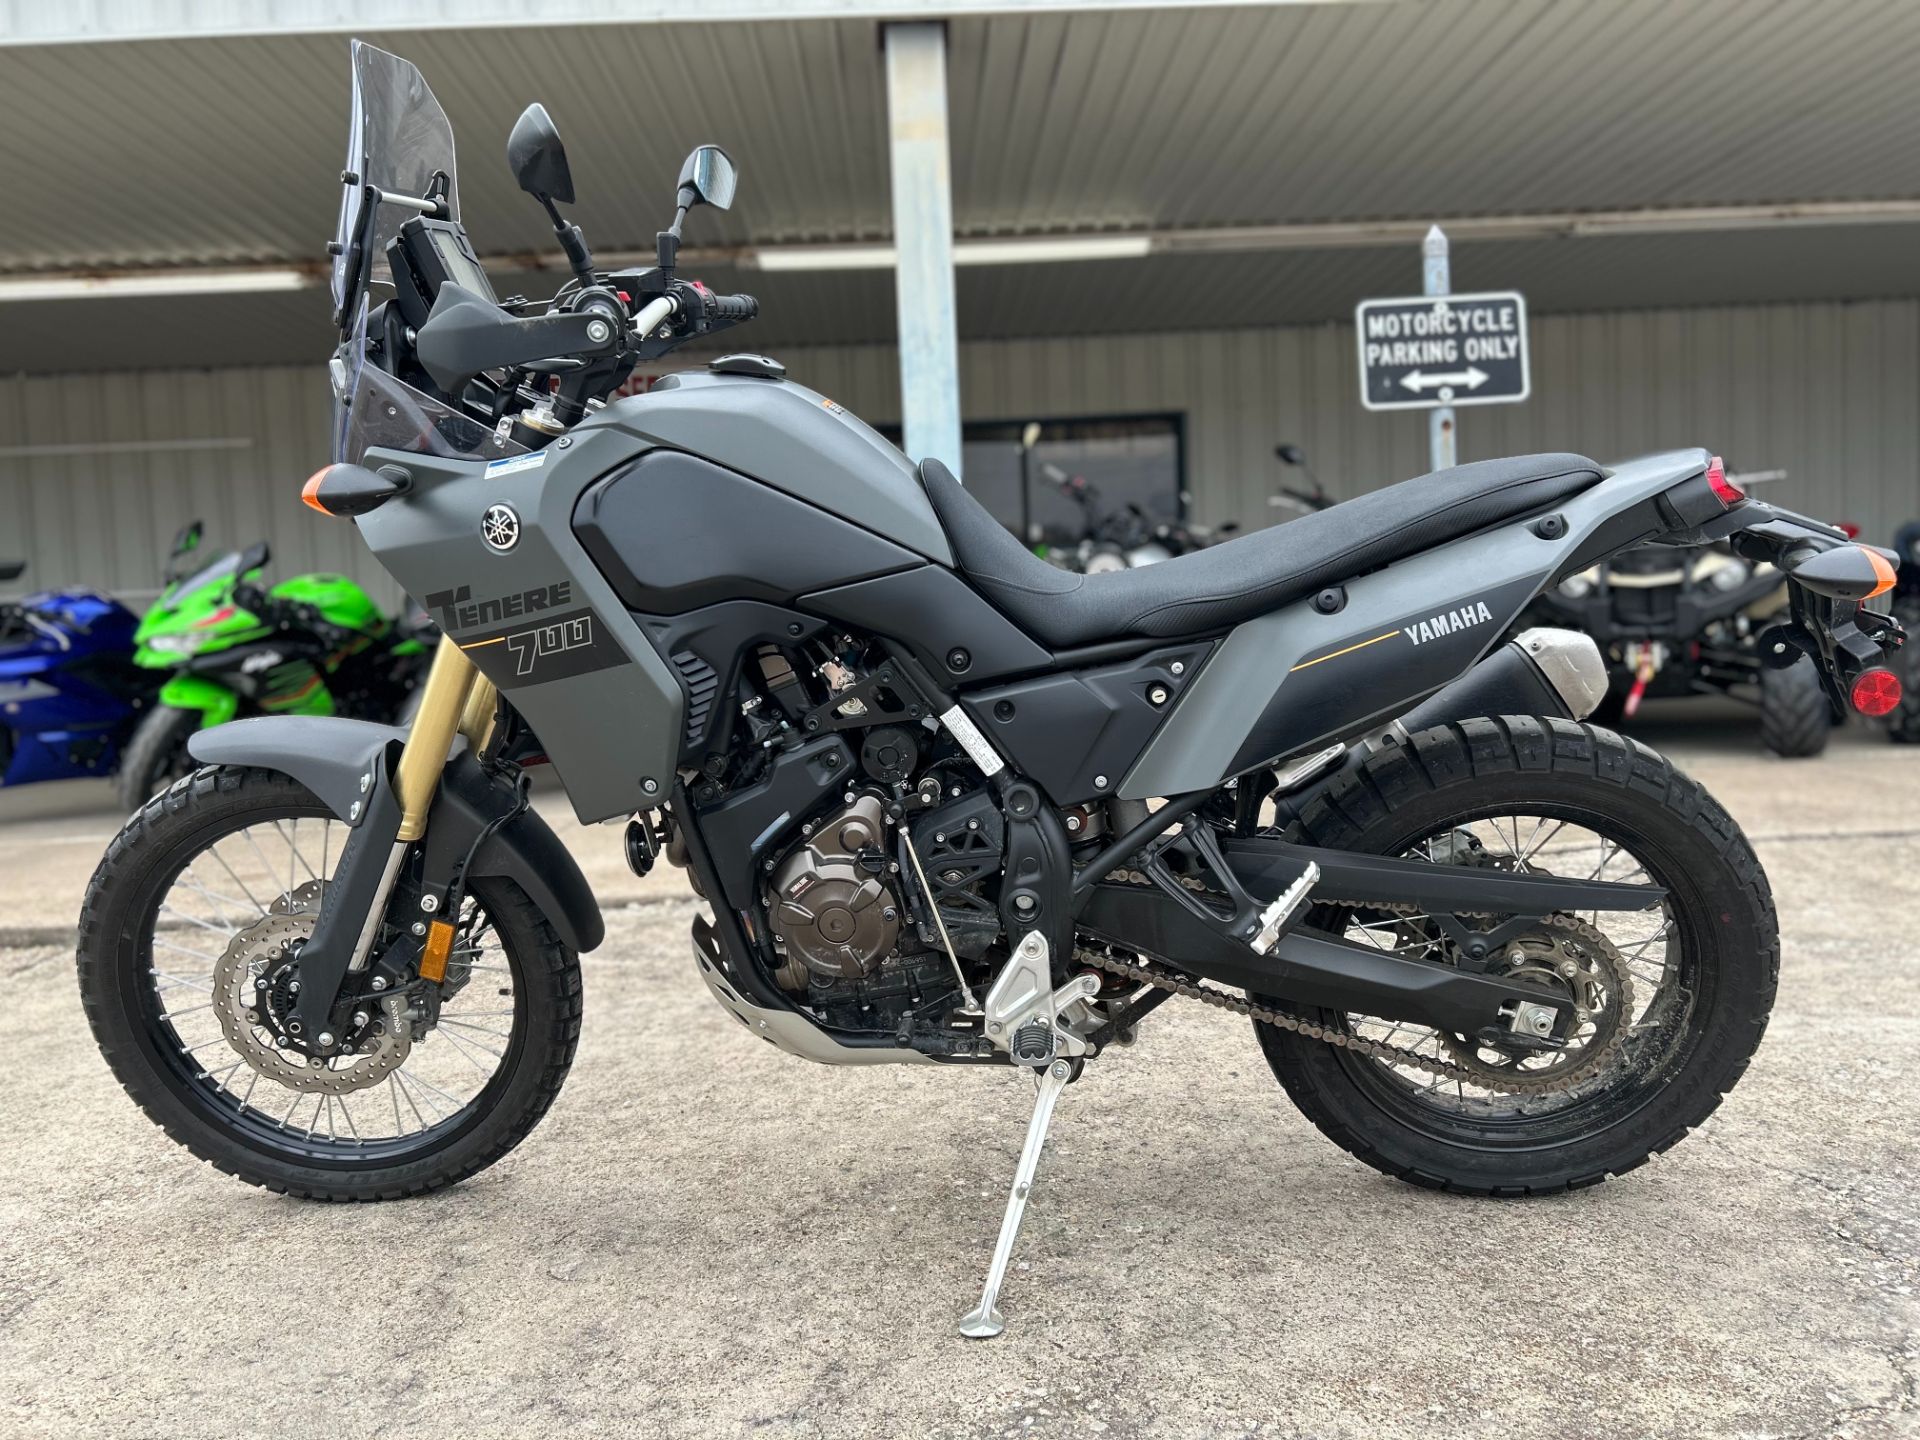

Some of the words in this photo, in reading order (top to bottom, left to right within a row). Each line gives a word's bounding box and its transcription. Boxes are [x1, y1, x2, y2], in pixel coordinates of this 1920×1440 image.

[1367, 307, 1515, 338] MOTORCYCLE
[1366, 338, 1458, 367] PARKING
[1464, 335, 1519, 361] ONLY
[1404, 601, 1493, 646] YAMAHA
[508, 616, 592, 676] 700
[390, 1000, 402, 1033] brembo
